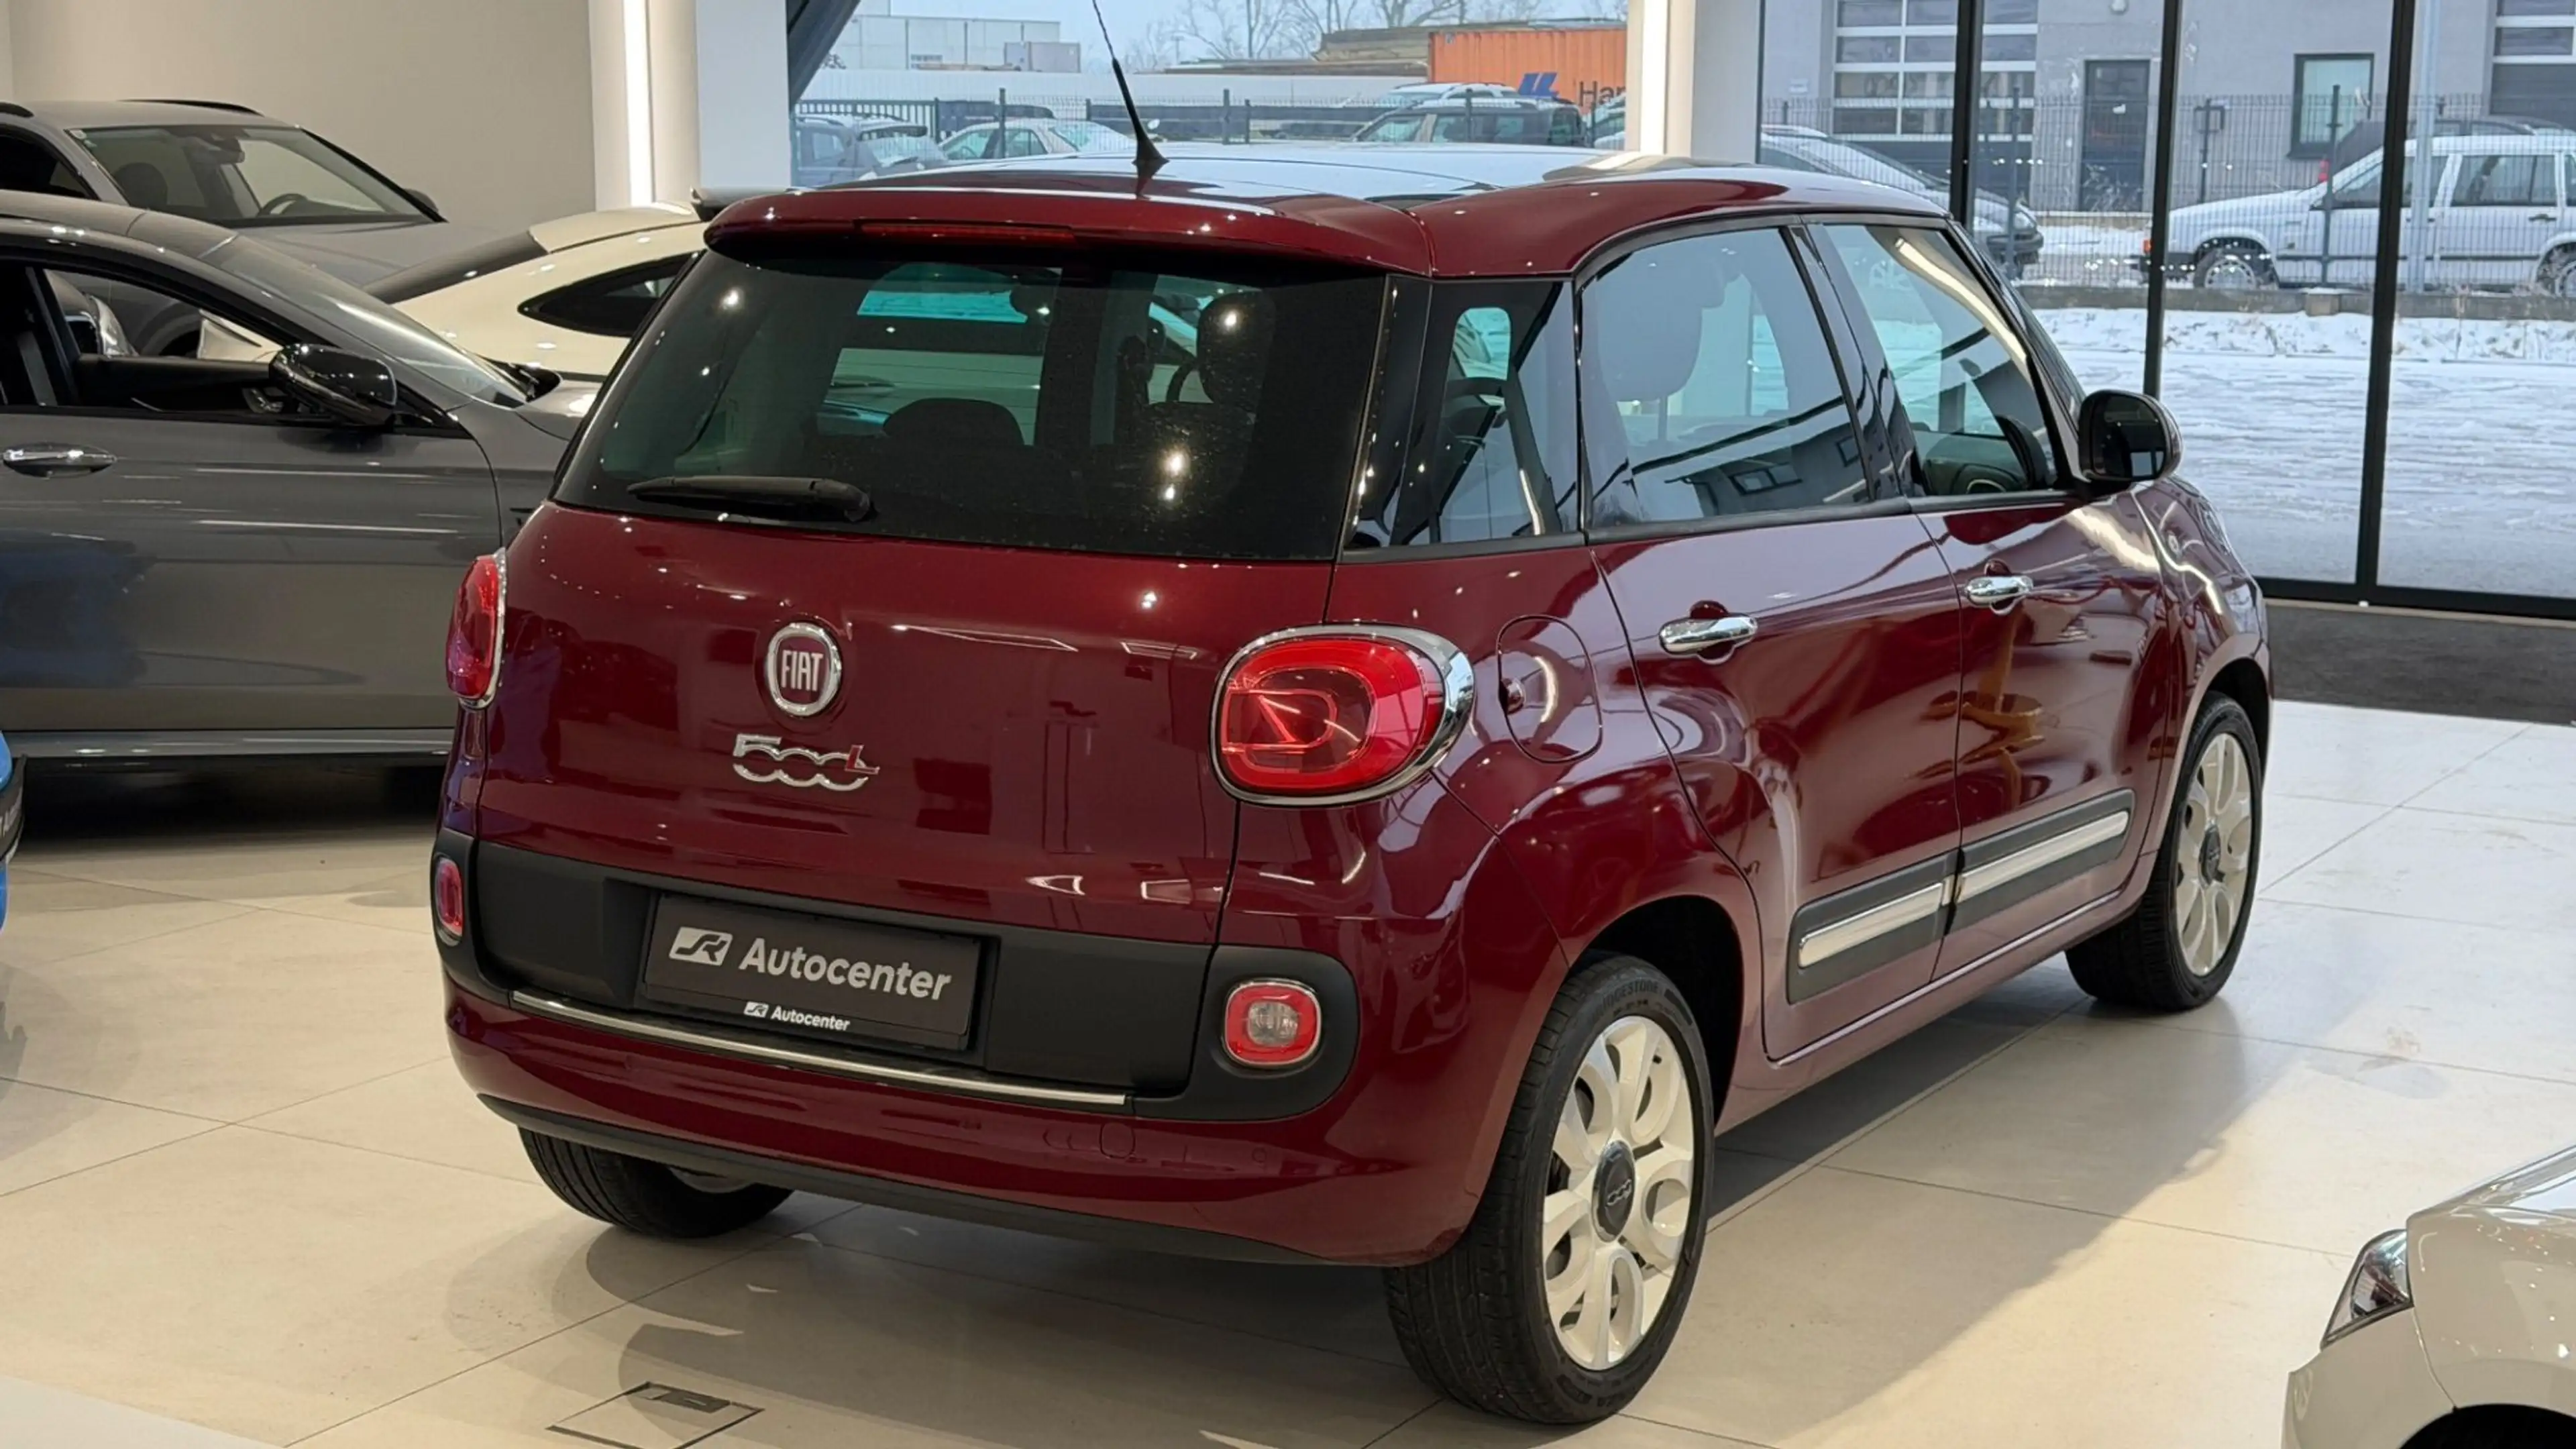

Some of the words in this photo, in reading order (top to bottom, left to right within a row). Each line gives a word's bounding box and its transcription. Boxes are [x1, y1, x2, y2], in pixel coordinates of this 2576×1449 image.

[781, 649, 823, 691] FIAT
[739, 938, 951, 1000] Autocenter
[771, 1006, 851, 1032] Autocenter
